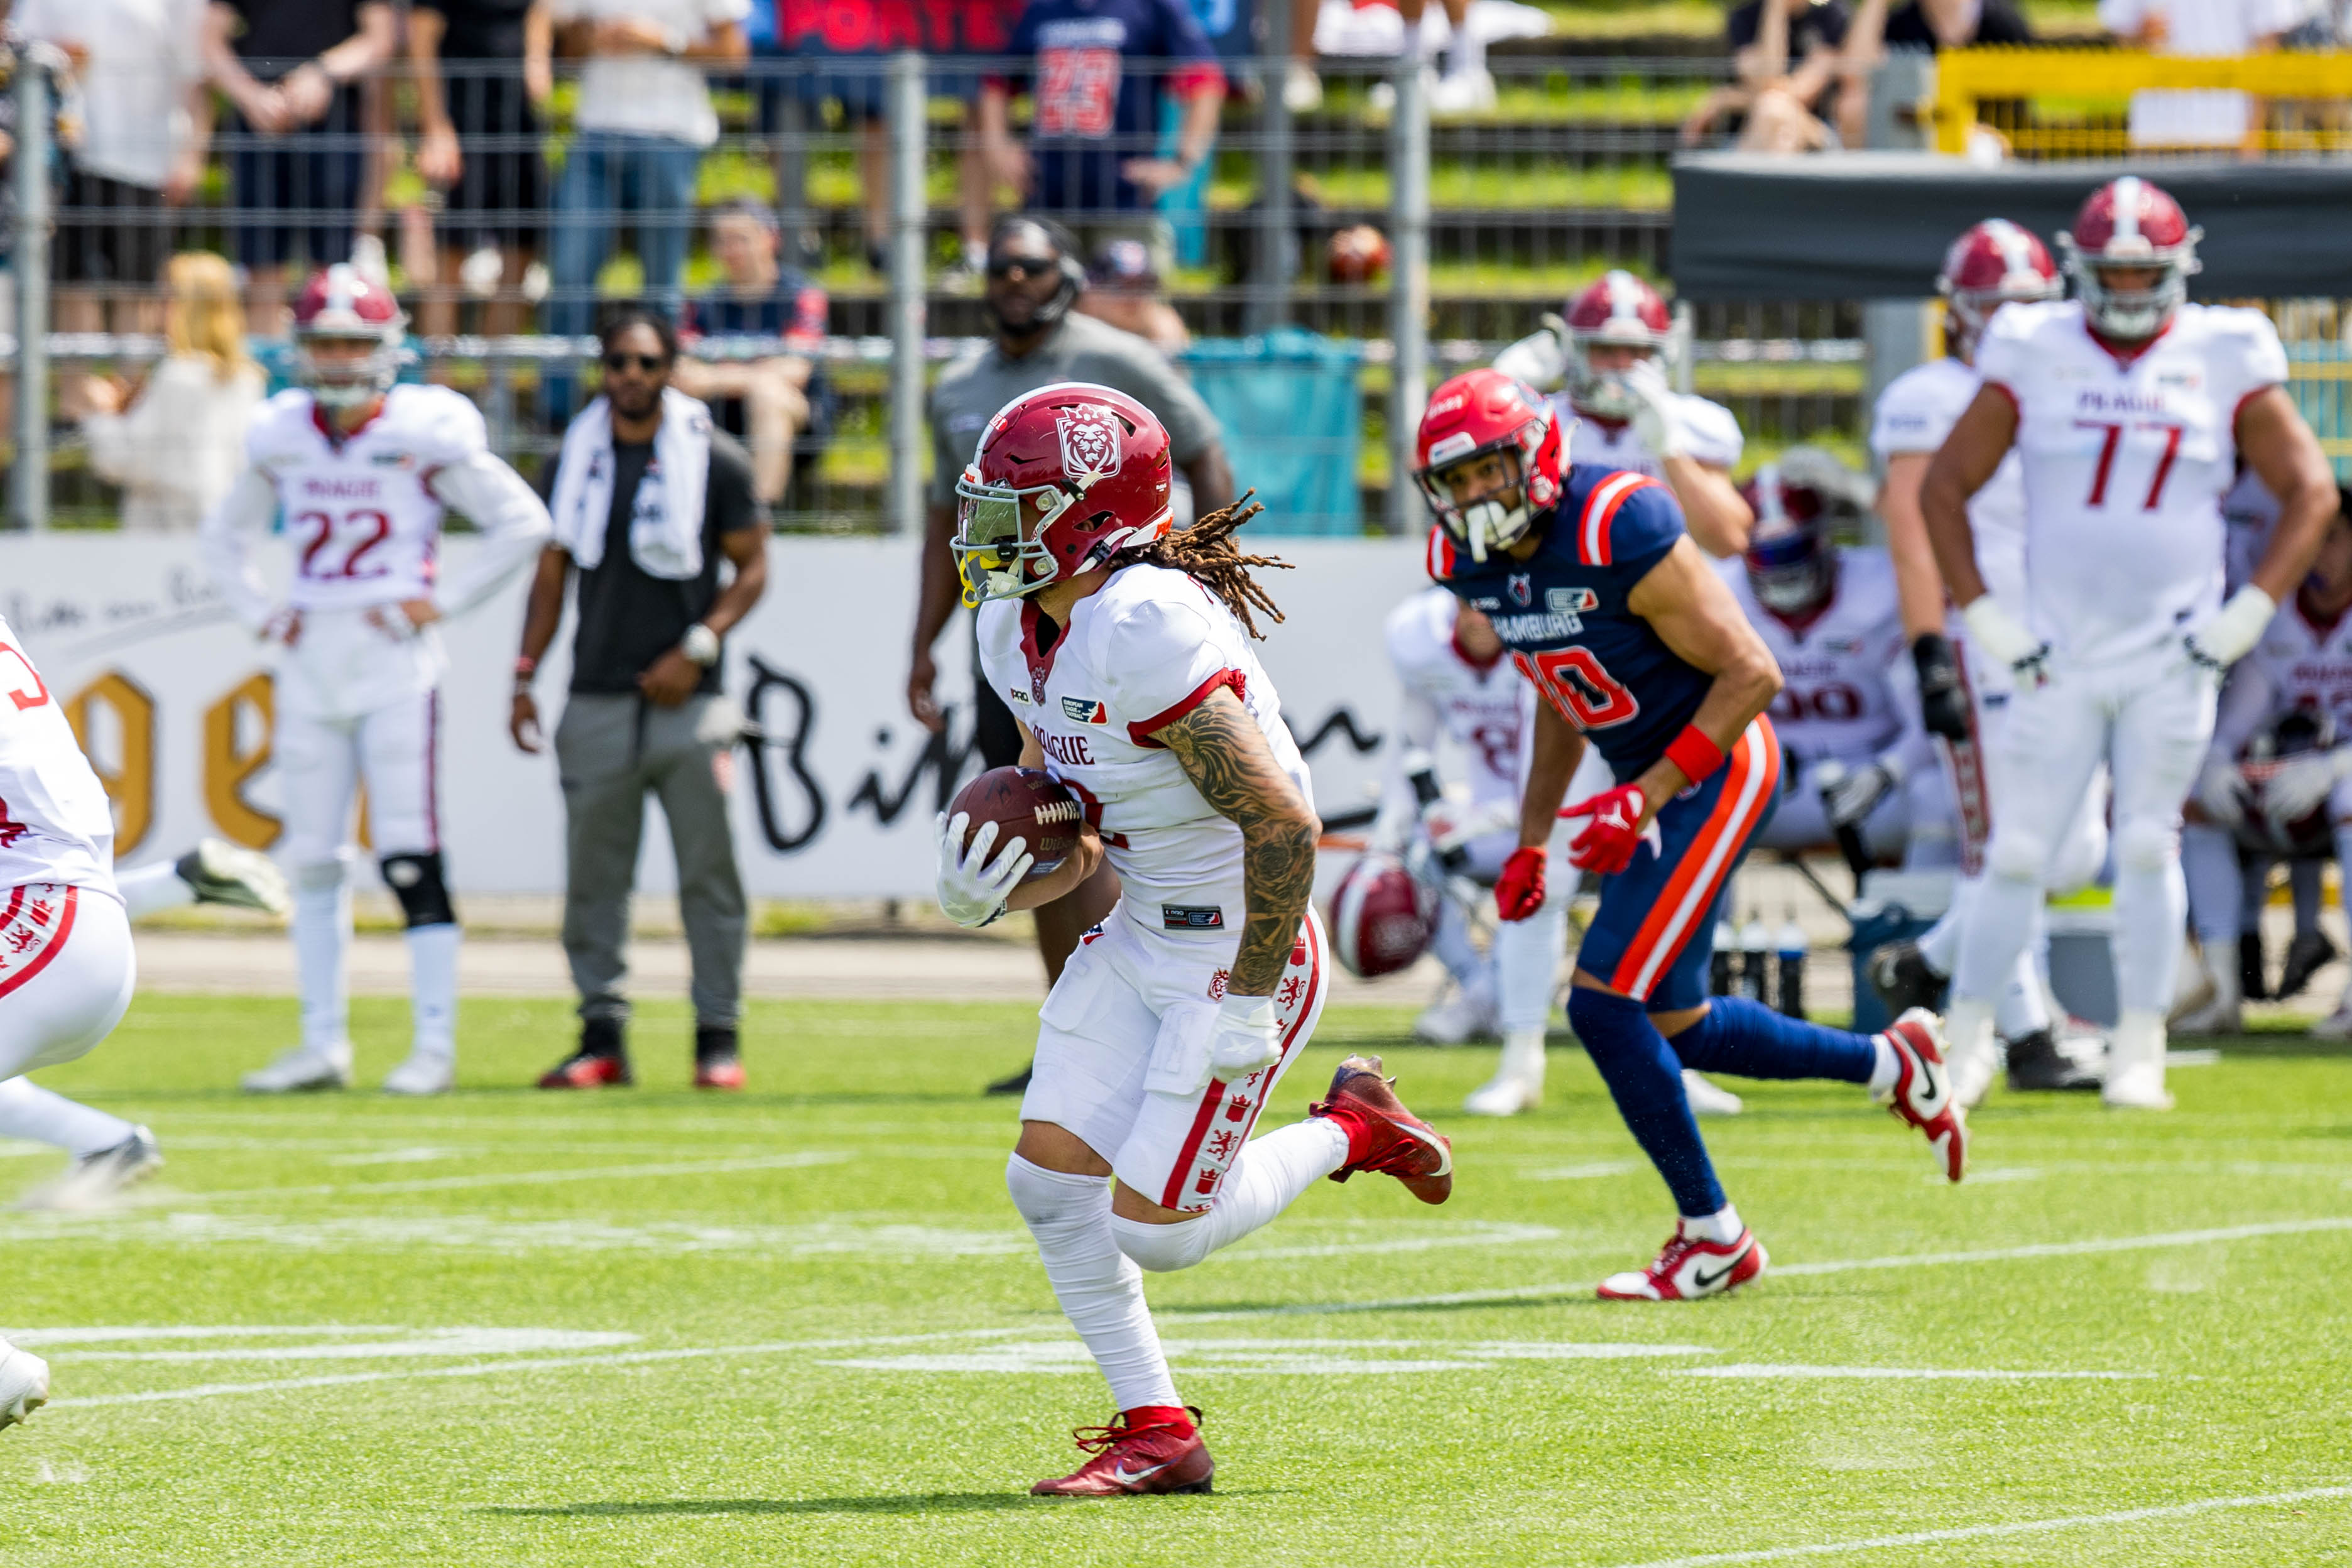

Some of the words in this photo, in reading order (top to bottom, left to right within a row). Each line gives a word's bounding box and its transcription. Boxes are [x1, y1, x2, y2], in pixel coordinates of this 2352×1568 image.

[2072, 420, 2184, 511] 77
[293, 509, 391, 579] 22
[1491, 611, 1585, 643] HAMBURG
[1013, 690, 1029, 702] PRO
[1063, 699, 1084, 708] EUROPEAN
[1065, 710, 1084, 719] FOOTBALL
[63, 667, 372, 856] ge
